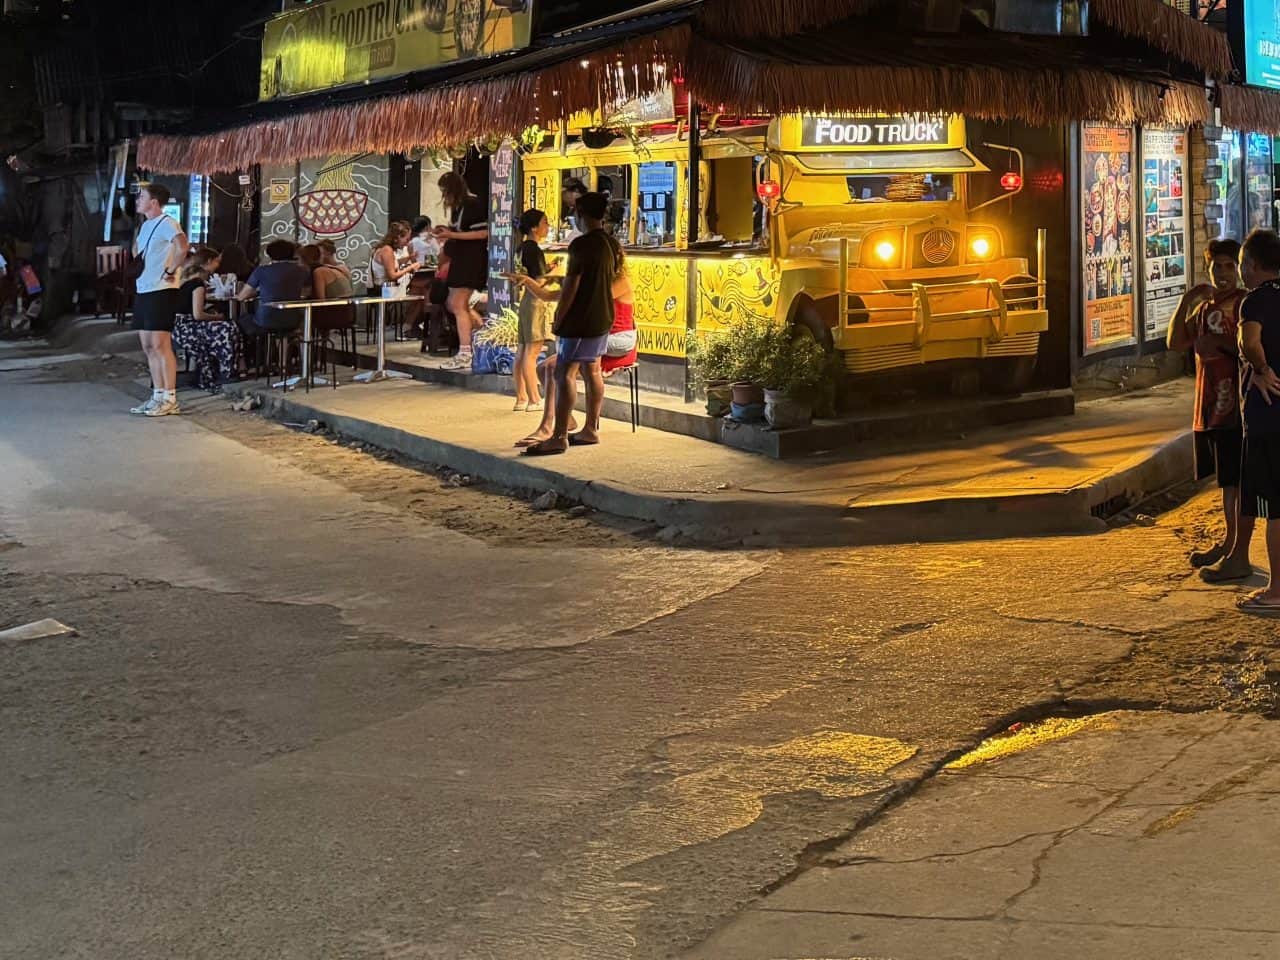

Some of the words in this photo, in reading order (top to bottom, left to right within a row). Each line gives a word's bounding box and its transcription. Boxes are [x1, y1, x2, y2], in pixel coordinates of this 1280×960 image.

[815, 124, 872, 144] FOOD
[874, 123, 939, 143] TRUCK
[655, 330, 674, 353] WOK
